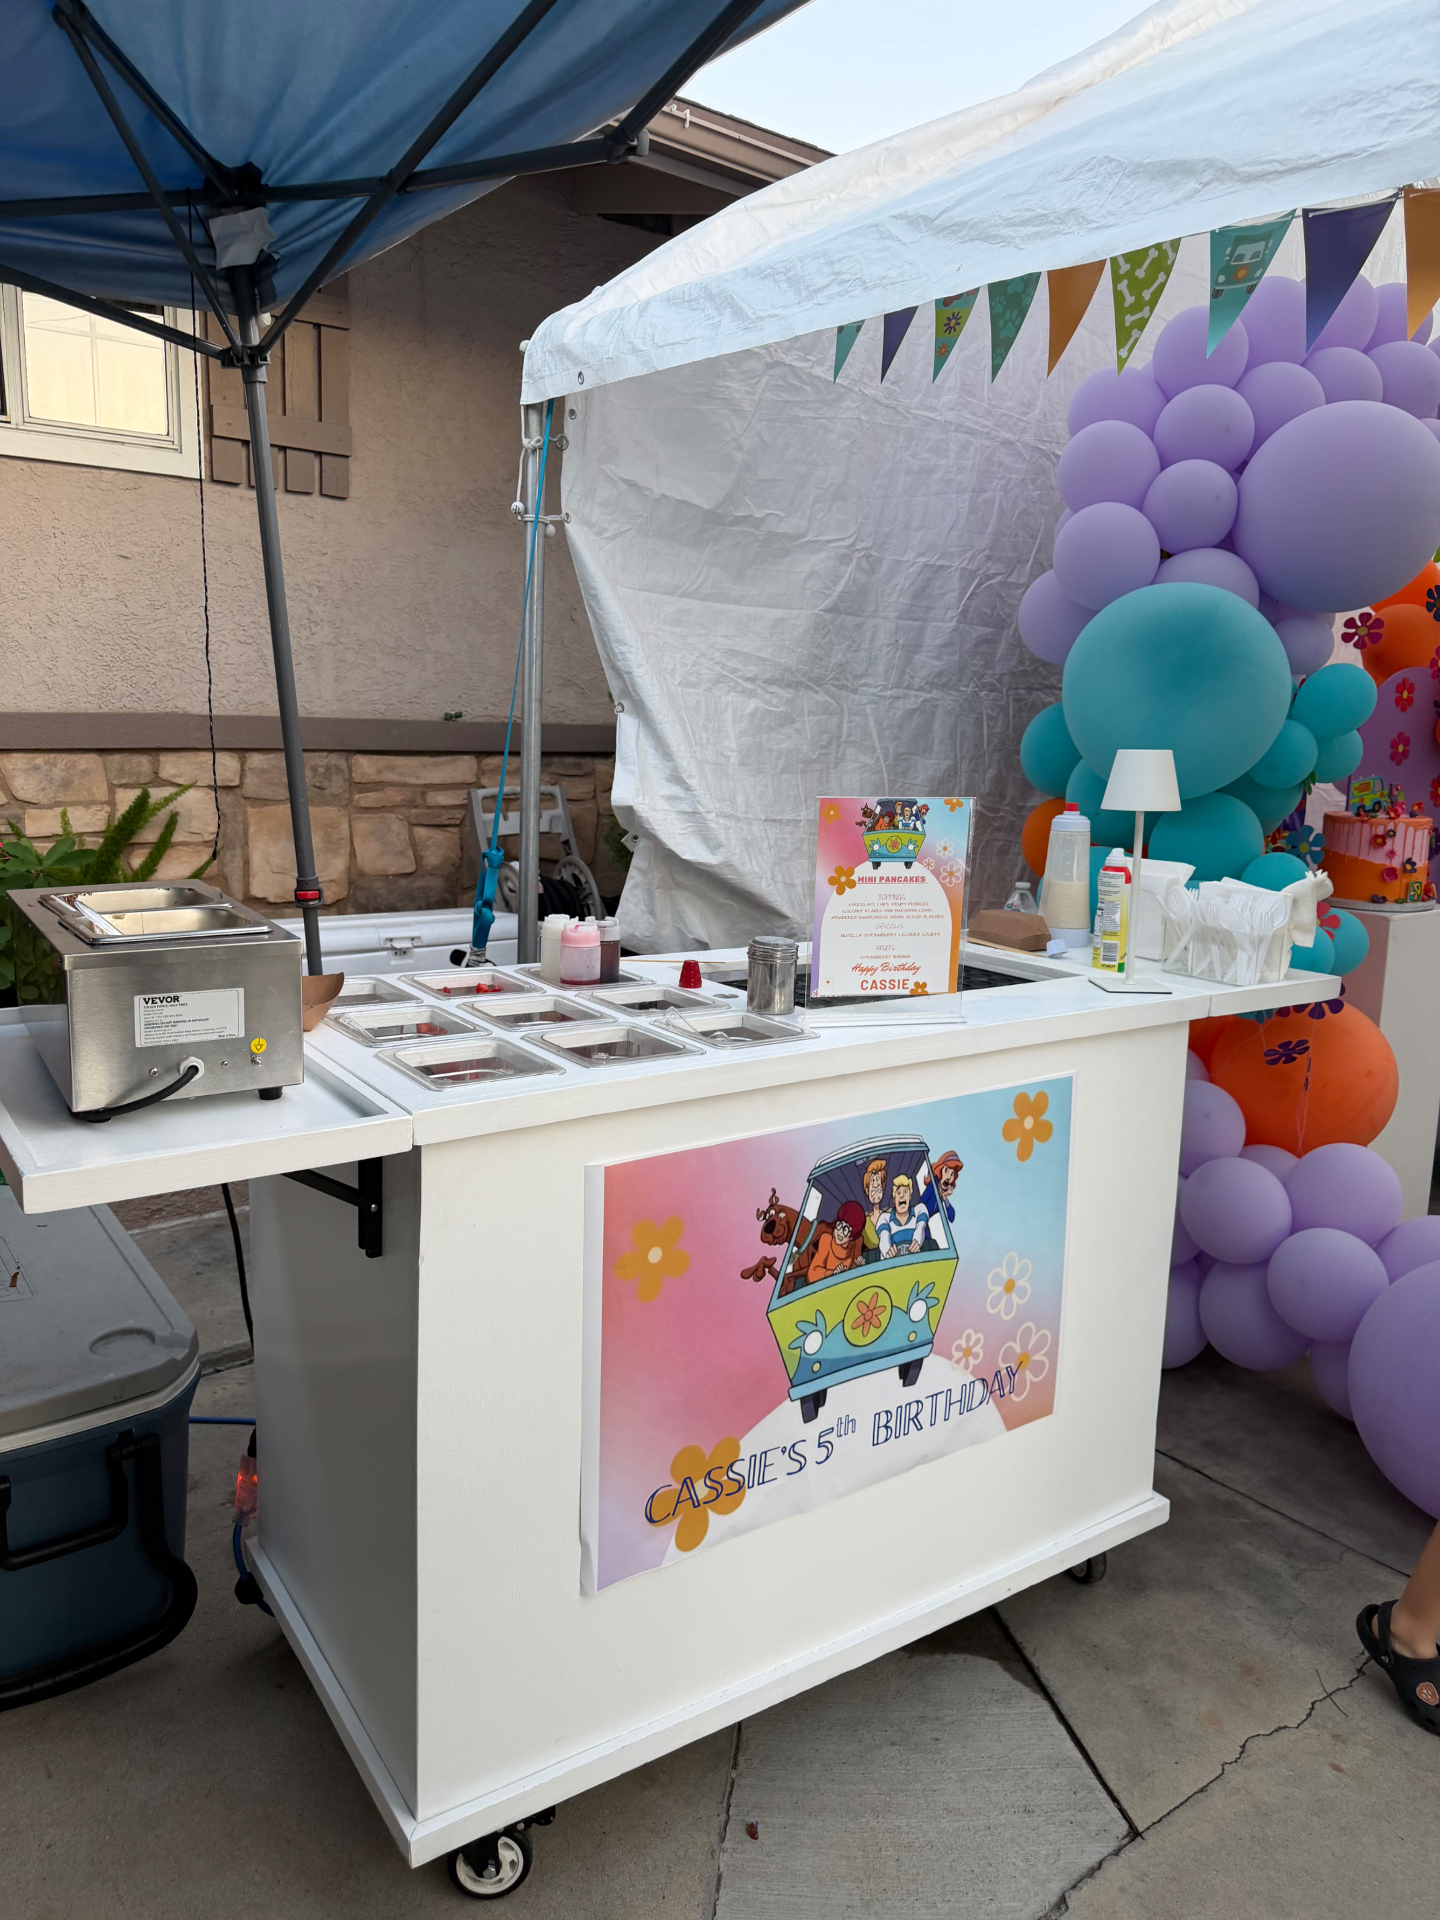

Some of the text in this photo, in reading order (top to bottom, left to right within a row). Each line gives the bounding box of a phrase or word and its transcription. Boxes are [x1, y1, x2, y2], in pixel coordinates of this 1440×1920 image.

[877, 893, 907, 901] TOPPINGS
[876, 944, 896, 952] FRUITS
[851, 961, 922, 976] Happy Birthday
[860, 978, 910, 991] CASSIE
[143, 995, 180, 1005] VEVOR
[644, 1360, 1023, 1524] CASSIE'S 5th BIRTHDAY
